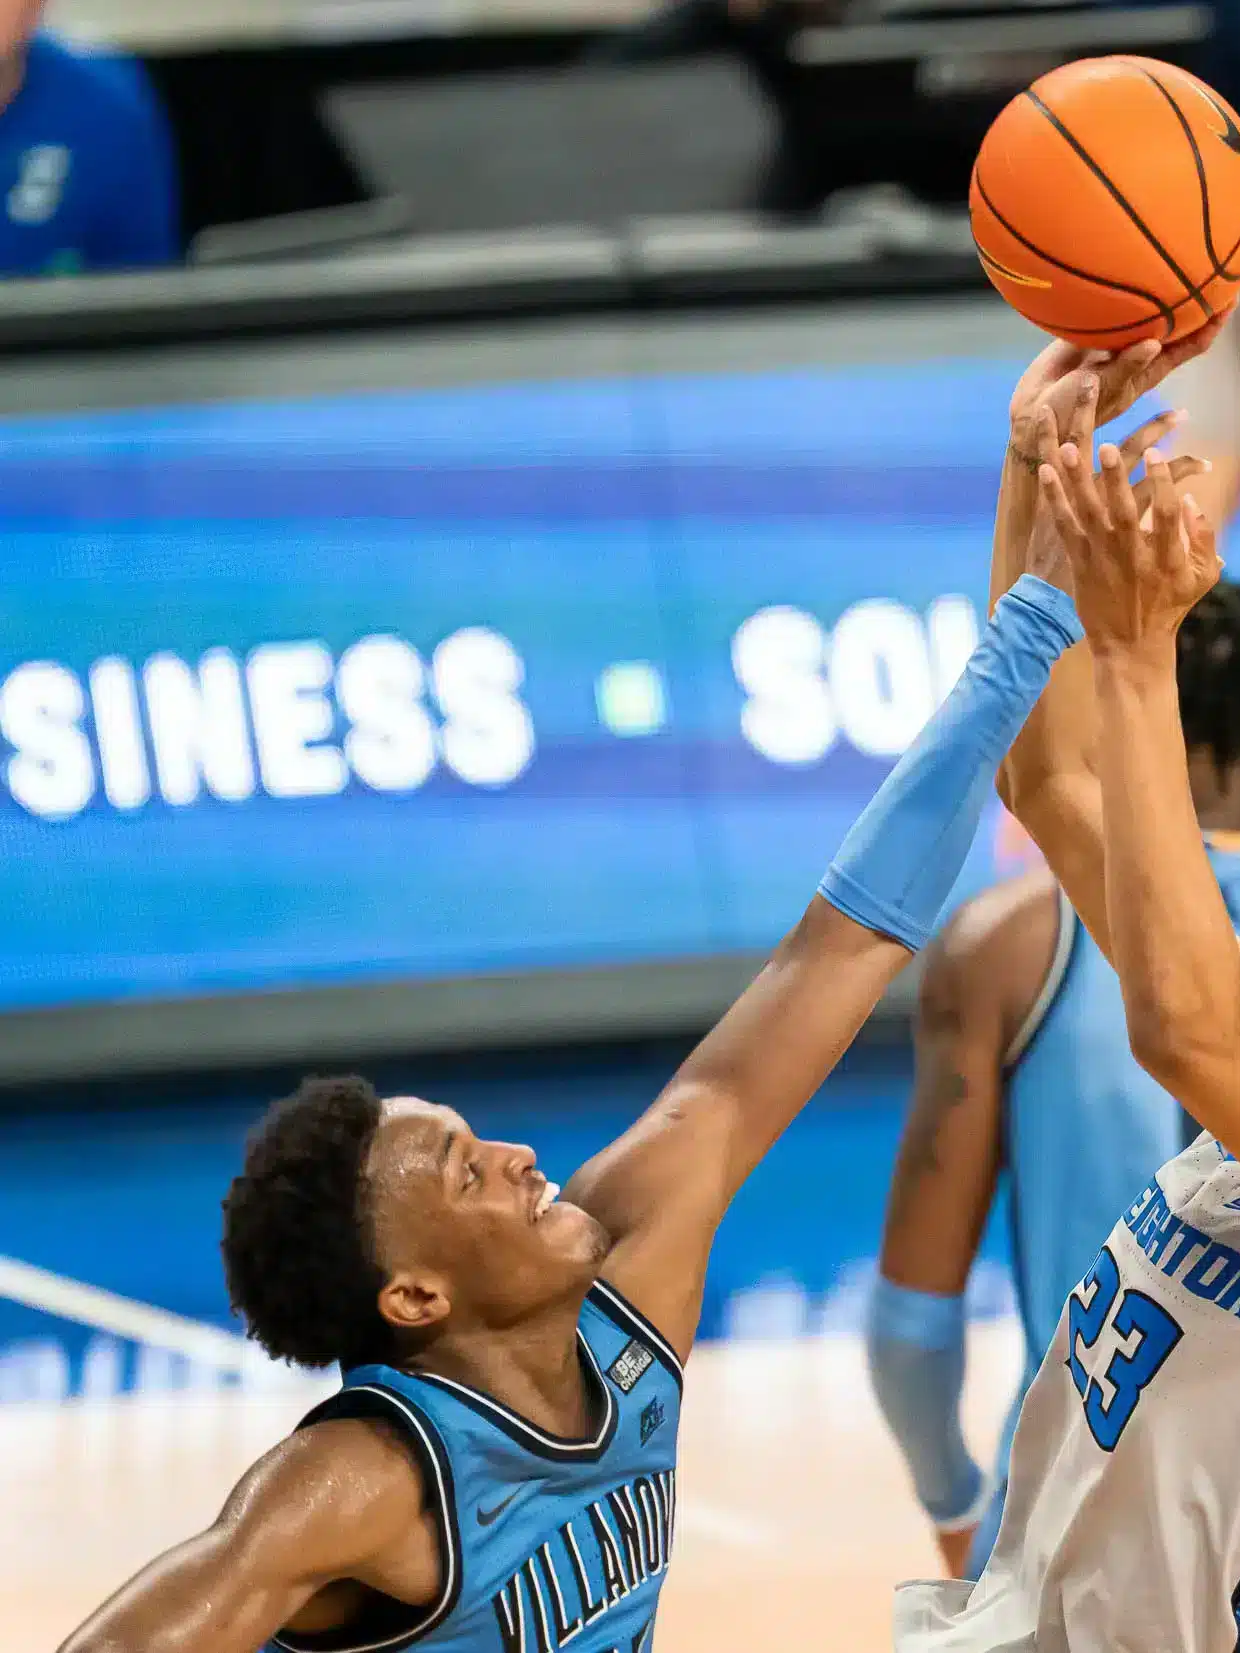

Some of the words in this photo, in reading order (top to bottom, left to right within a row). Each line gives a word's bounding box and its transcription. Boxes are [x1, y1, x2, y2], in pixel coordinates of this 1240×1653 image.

[0, 626, 535, 818] SINESS
[614, 1350, 637, 1378] BE
[620, 1351, 653, 1392] CHANGE
[1064, 1245, 1185, 1453] 23
